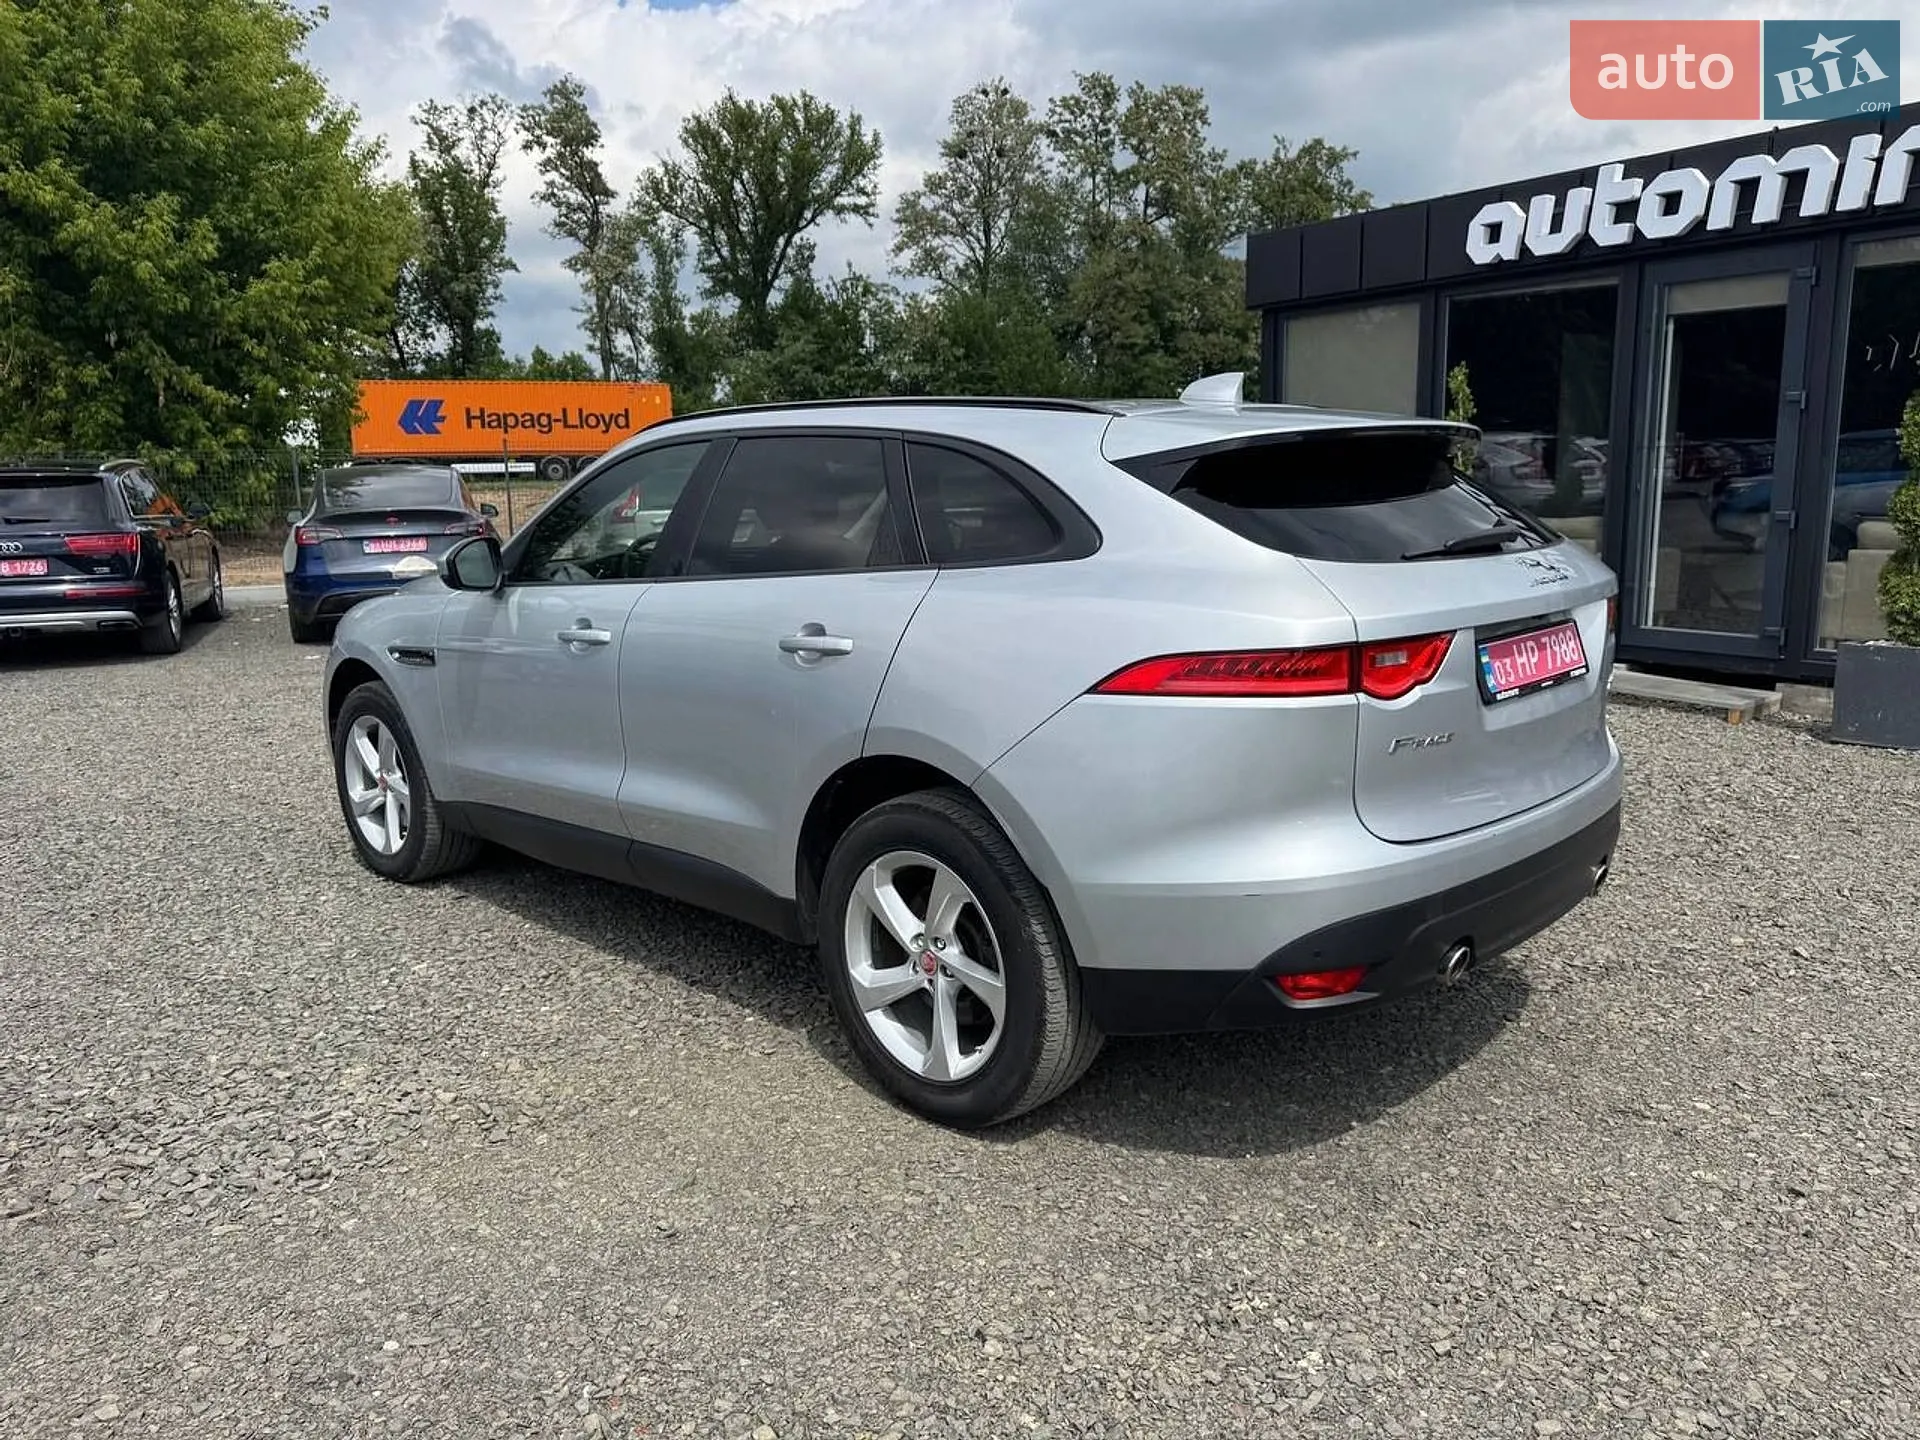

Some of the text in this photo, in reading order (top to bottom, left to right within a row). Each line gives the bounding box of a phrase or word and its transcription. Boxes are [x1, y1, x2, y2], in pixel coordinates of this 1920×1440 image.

[464, 407, 630, 435] Hapag-Lloyd
[1494, 658, 1515, 685] 03
[1513, 640, 1539, 678] HP
[1541, 629, 1579, 670] 7988
